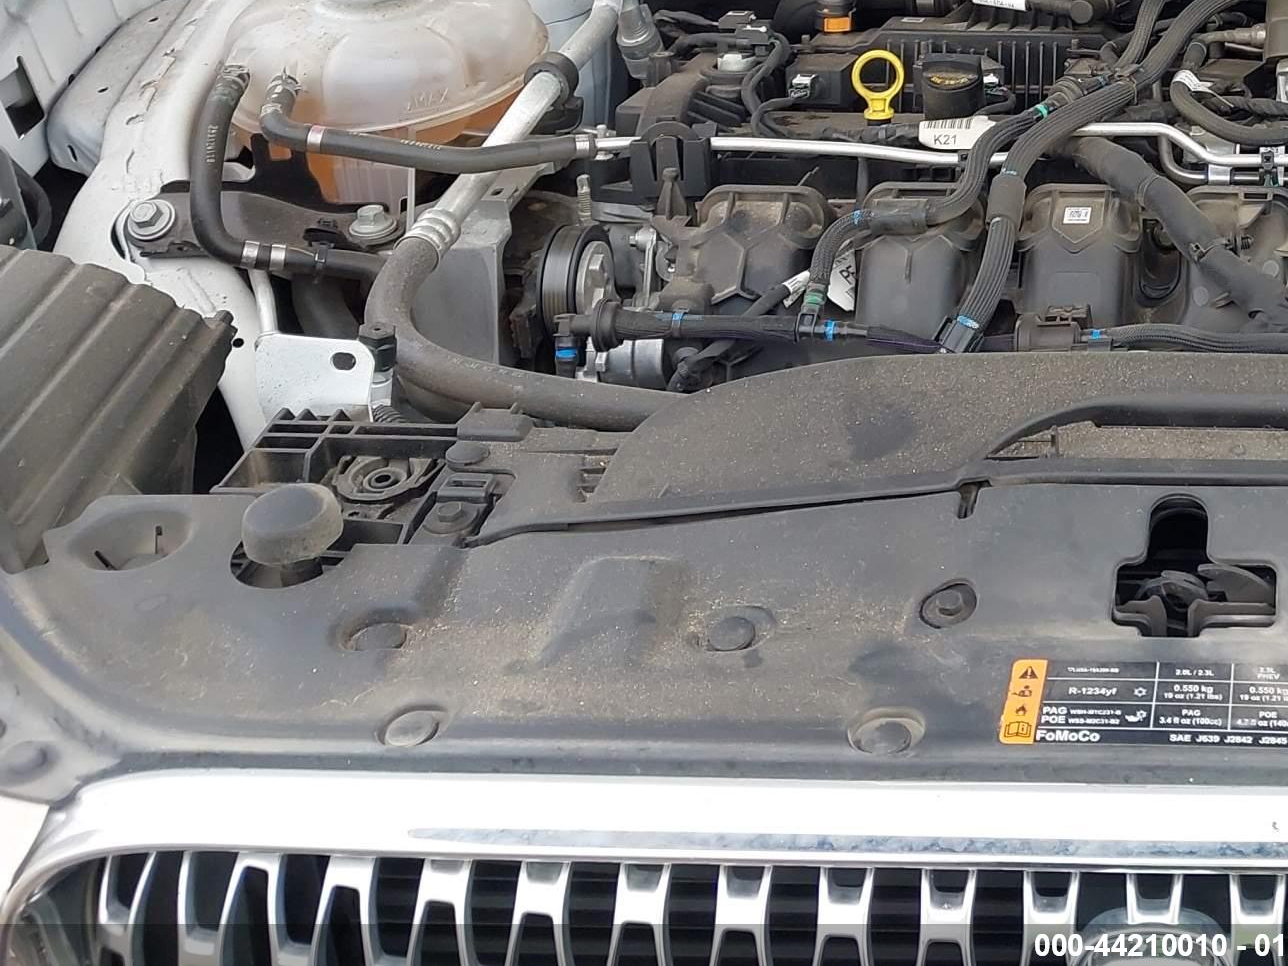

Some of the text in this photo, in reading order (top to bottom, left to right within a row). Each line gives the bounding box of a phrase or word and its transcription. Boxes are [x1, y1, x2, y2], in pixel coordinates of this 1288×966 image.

[933, 134, 957, 146] K21
[1068, 687, 1117, 696] R-1234yf
[1173, 684, 1214, 694] 0.550 kg
[1249, 686, 1288, 696] 0.550 kg
[1042, 706, 1067, 715] PAG
[1181, 709, 1201, 717] PAG
[1258, 710, 1278, 719] POE
[1041, 715, 1066, 724] POE
[1036, 730, 1100, 742] FoMoCo
[1169, 734, 1192, 742] SAE
[1195, 734, 1220, 743] J639
